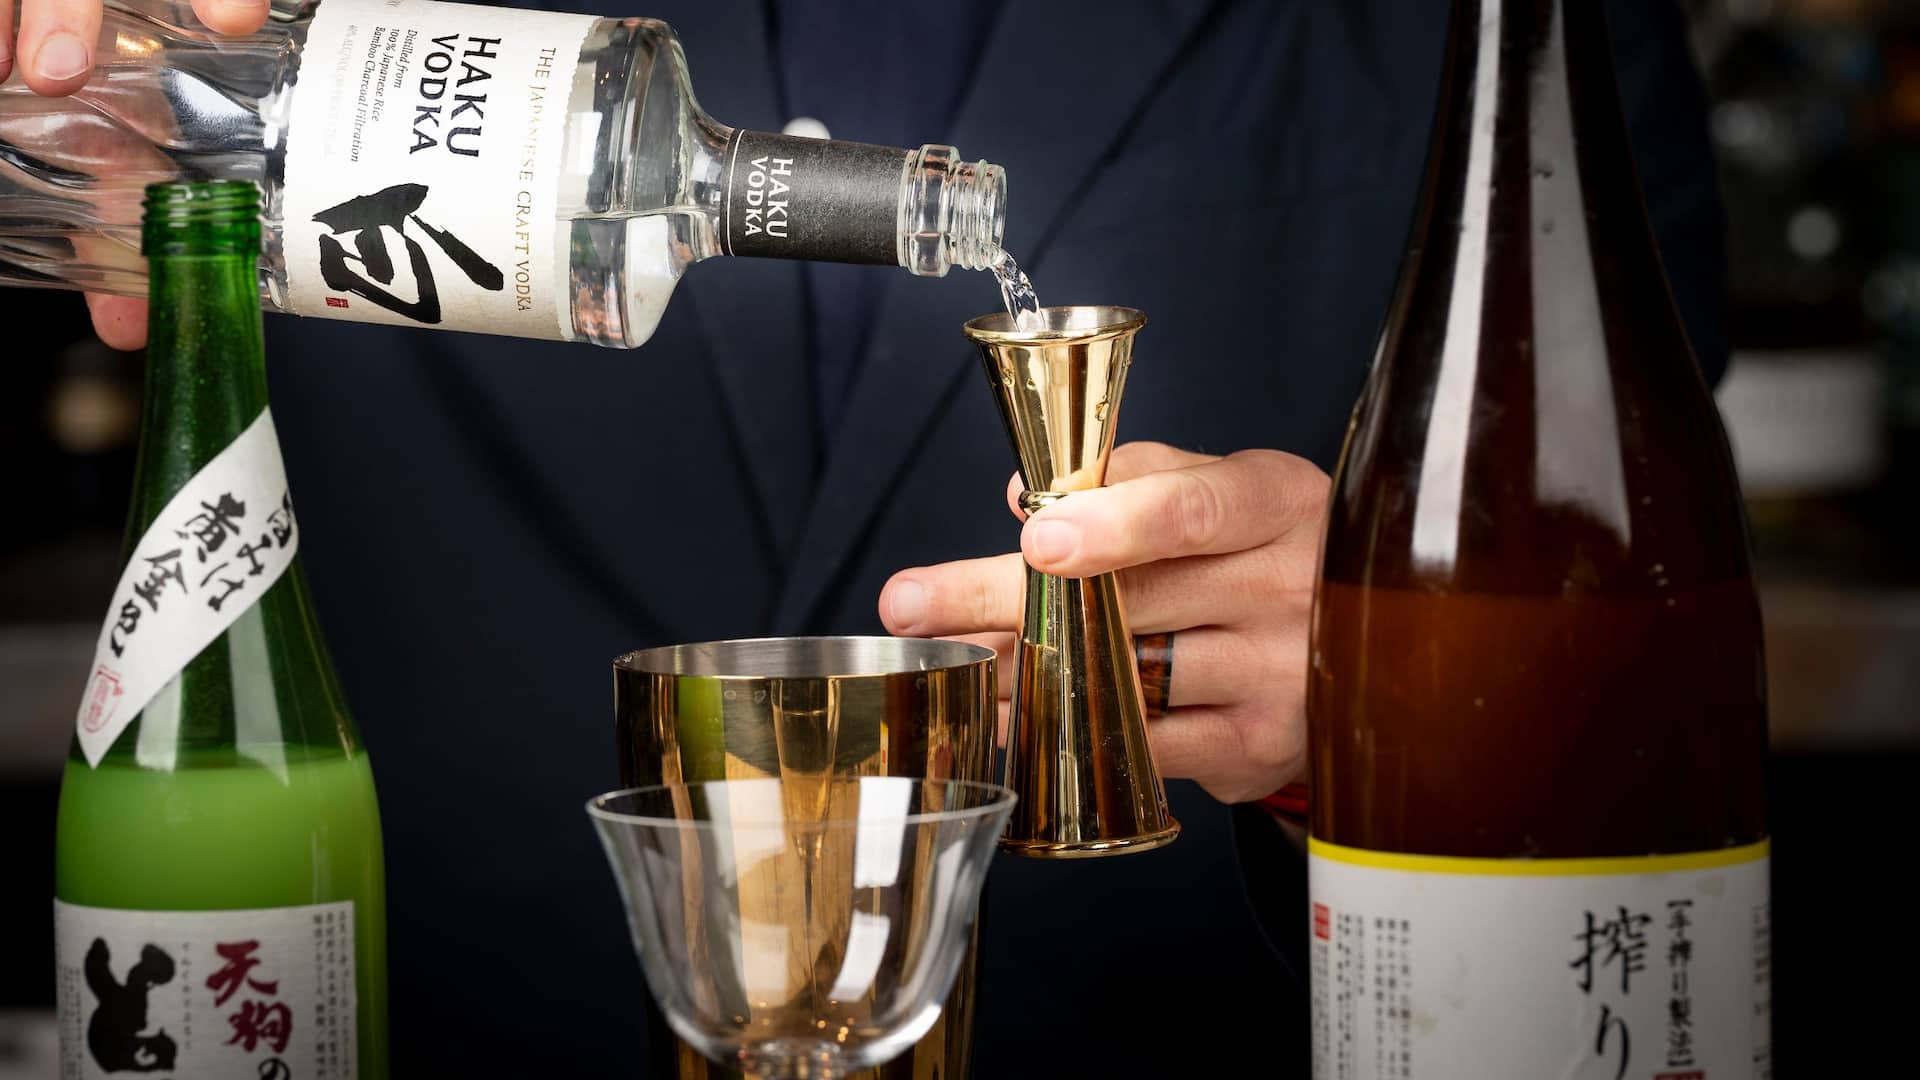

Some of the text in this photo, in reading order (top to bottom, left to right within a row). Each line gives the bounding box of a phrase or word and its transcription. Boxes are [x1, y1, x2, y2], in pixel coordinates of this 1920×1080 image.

[350, 26, 386, 163] Bamboo Charcoal Filtration
[371, 28, 400, 122] 100% Japanese Rice
[393, 29, 418, 89] Distilled from
[409, 33, 460, 155] VODKA
[446, 36, 502, 158] HAKU
[535, 47, 557, 78] THE
[515, 191, 532, 255] CRAFT
[744, 156, 769, 236] VODKA
[766, 158, 794, 238] HAKU
[311, 182, 504, 324] 白
[515, 260, 533, 312] VODKA
